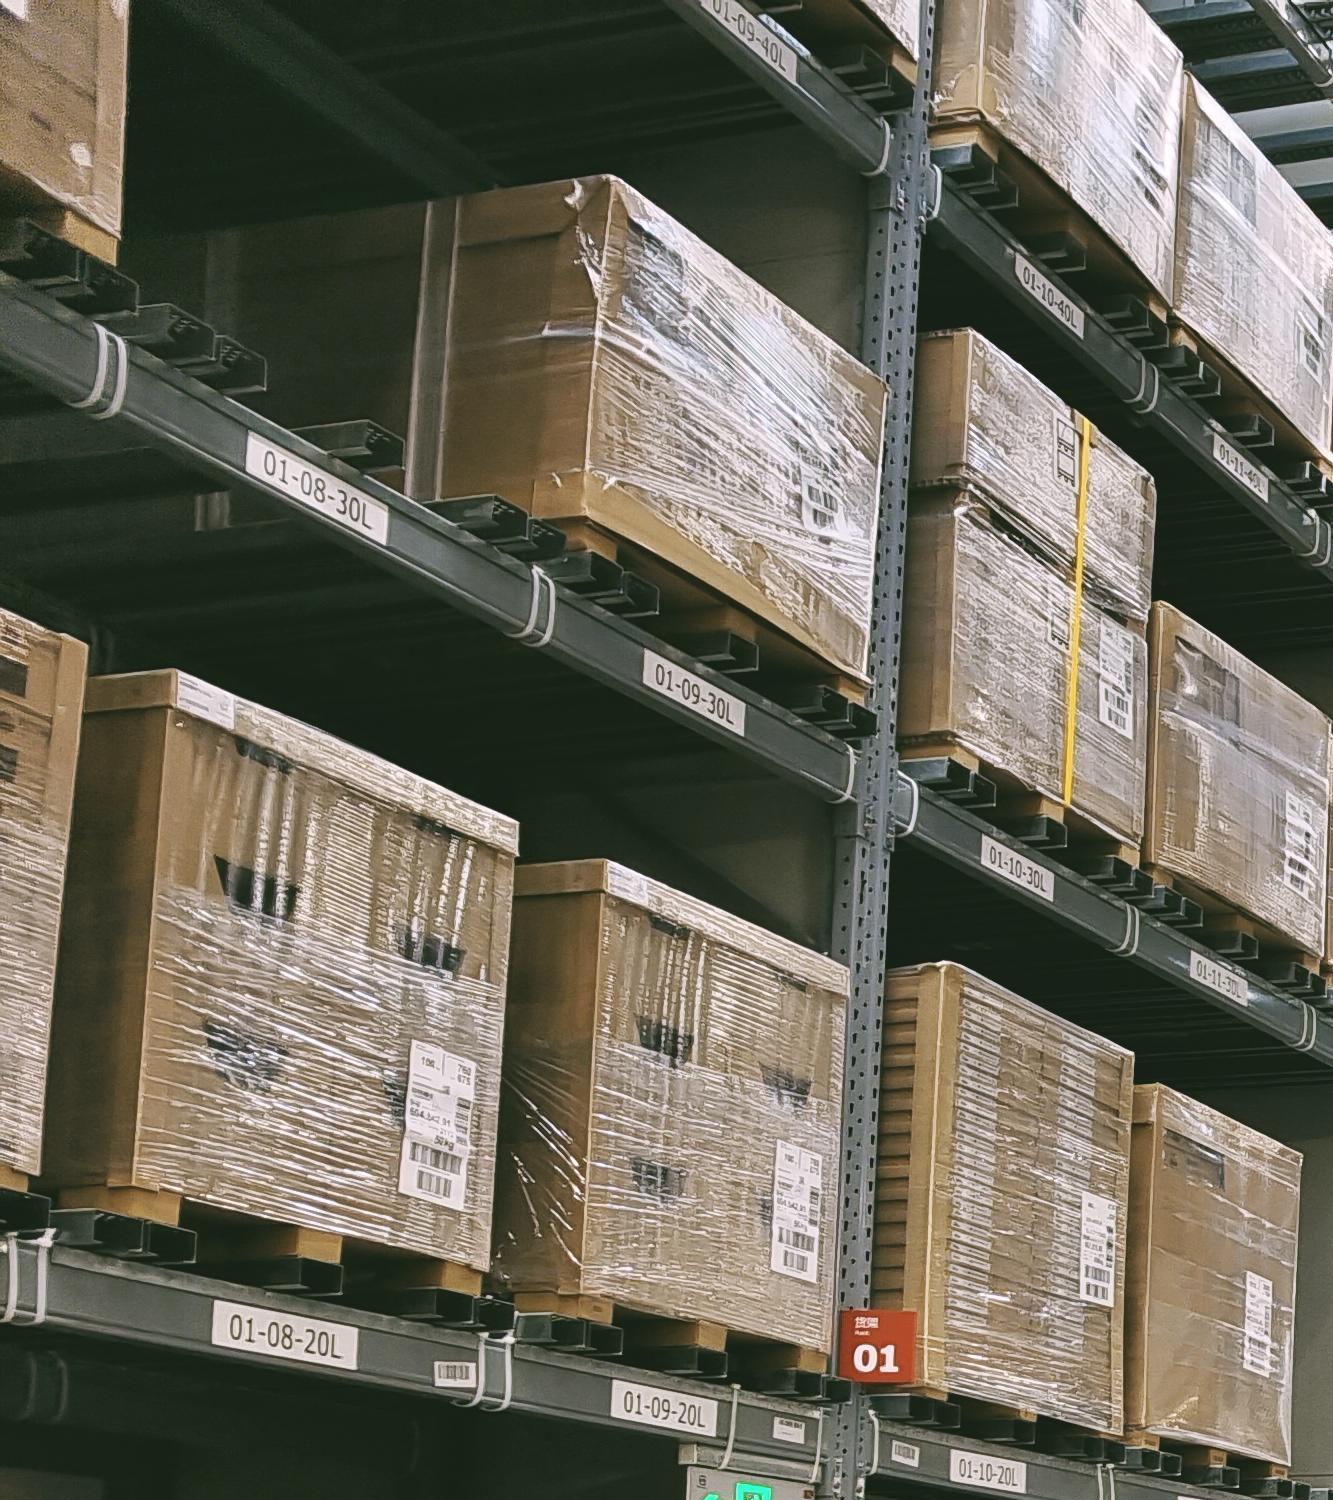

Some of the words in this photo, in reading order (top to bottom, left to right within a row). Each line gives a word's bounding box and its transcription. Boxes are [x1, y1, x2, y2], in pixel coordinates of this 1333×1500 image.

[264, 450, 373, 531] 01-08-30L
[655, 663, 734, 725] 01-09-30L
[988, 844, 1048, 892] 01-10-30L
[1196, 956, 1244, 1000] 01-11-30L
[228, 1313, 343, 1360] 01-08-20L
[853, 1344, 899, 1373] 01
[623, 1389, 706, 1429] 01-09-20L
[958, 1461, 1019, 1489] 01-10-20L
